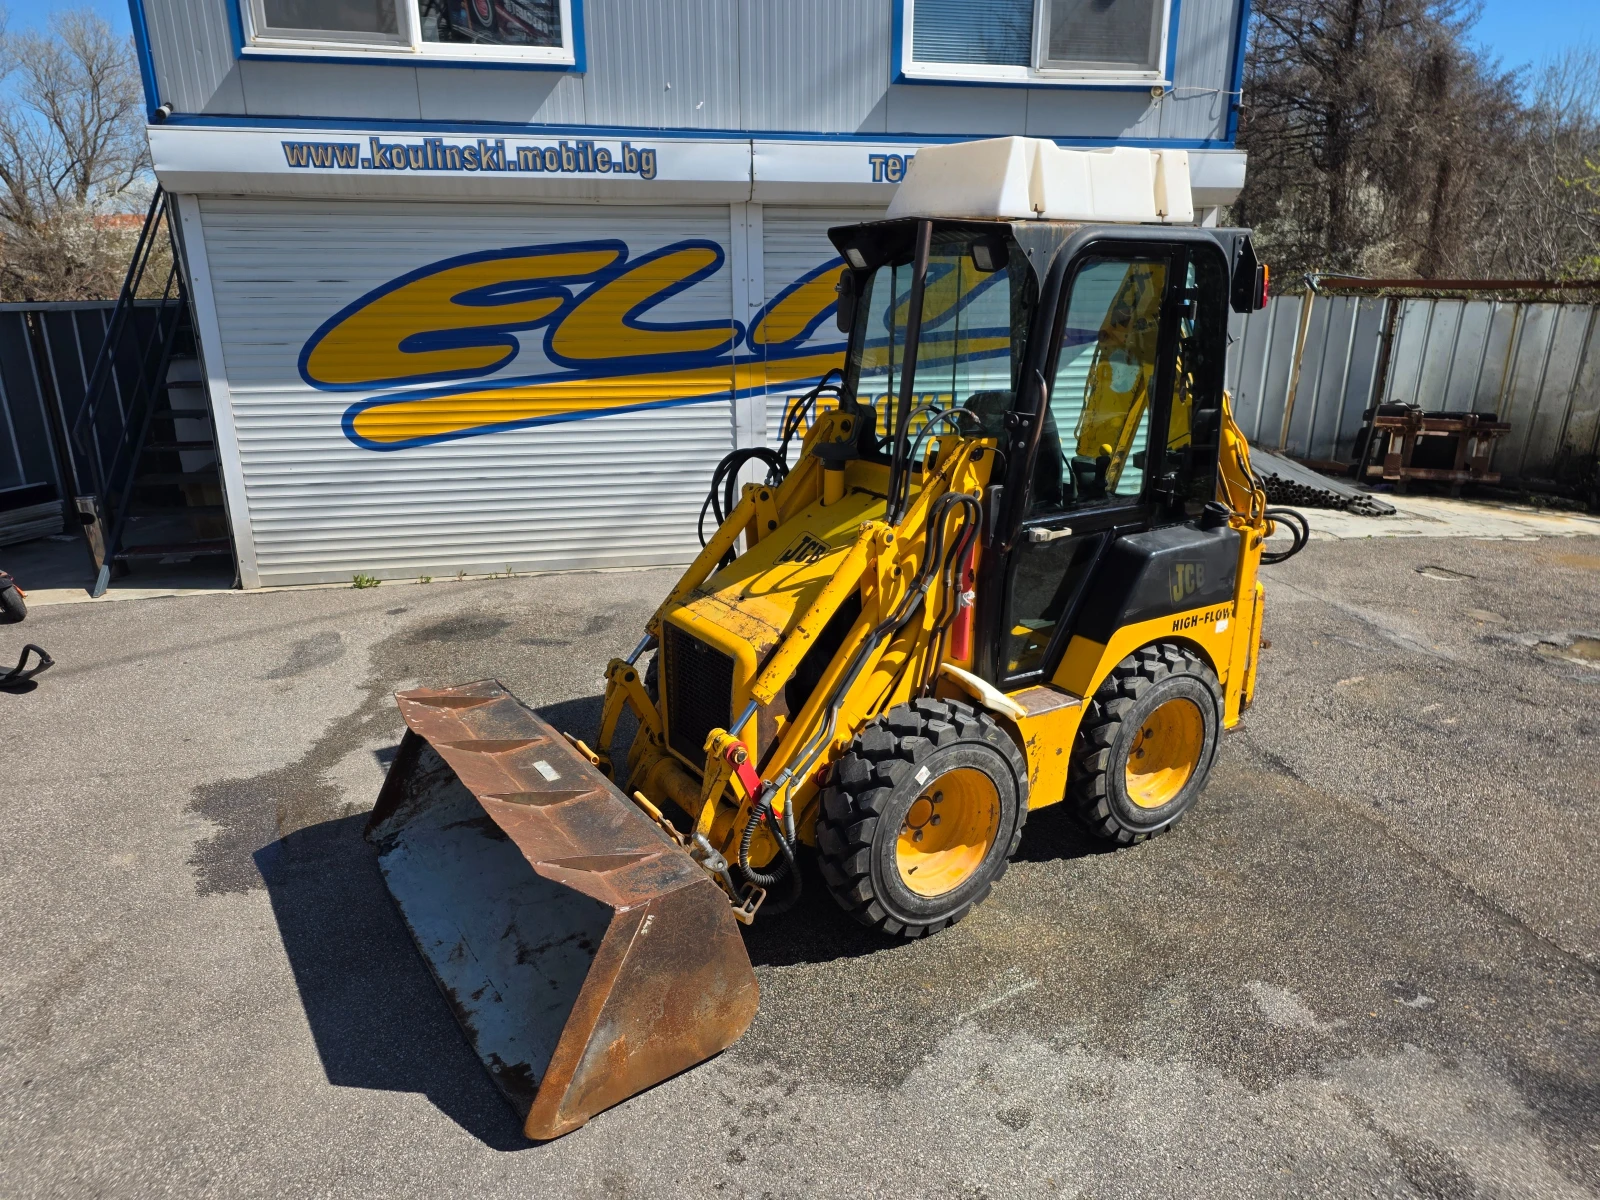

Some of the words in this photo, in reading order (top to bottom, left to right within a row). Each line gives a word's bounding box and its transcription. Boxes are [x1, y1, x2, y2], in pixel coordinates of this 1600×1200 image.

[281, 137, 657, 180] www.koulinski.mobile.bg
[778, 535, 827, 564] JCB
[1172, 563, 1205, 602] JCB
